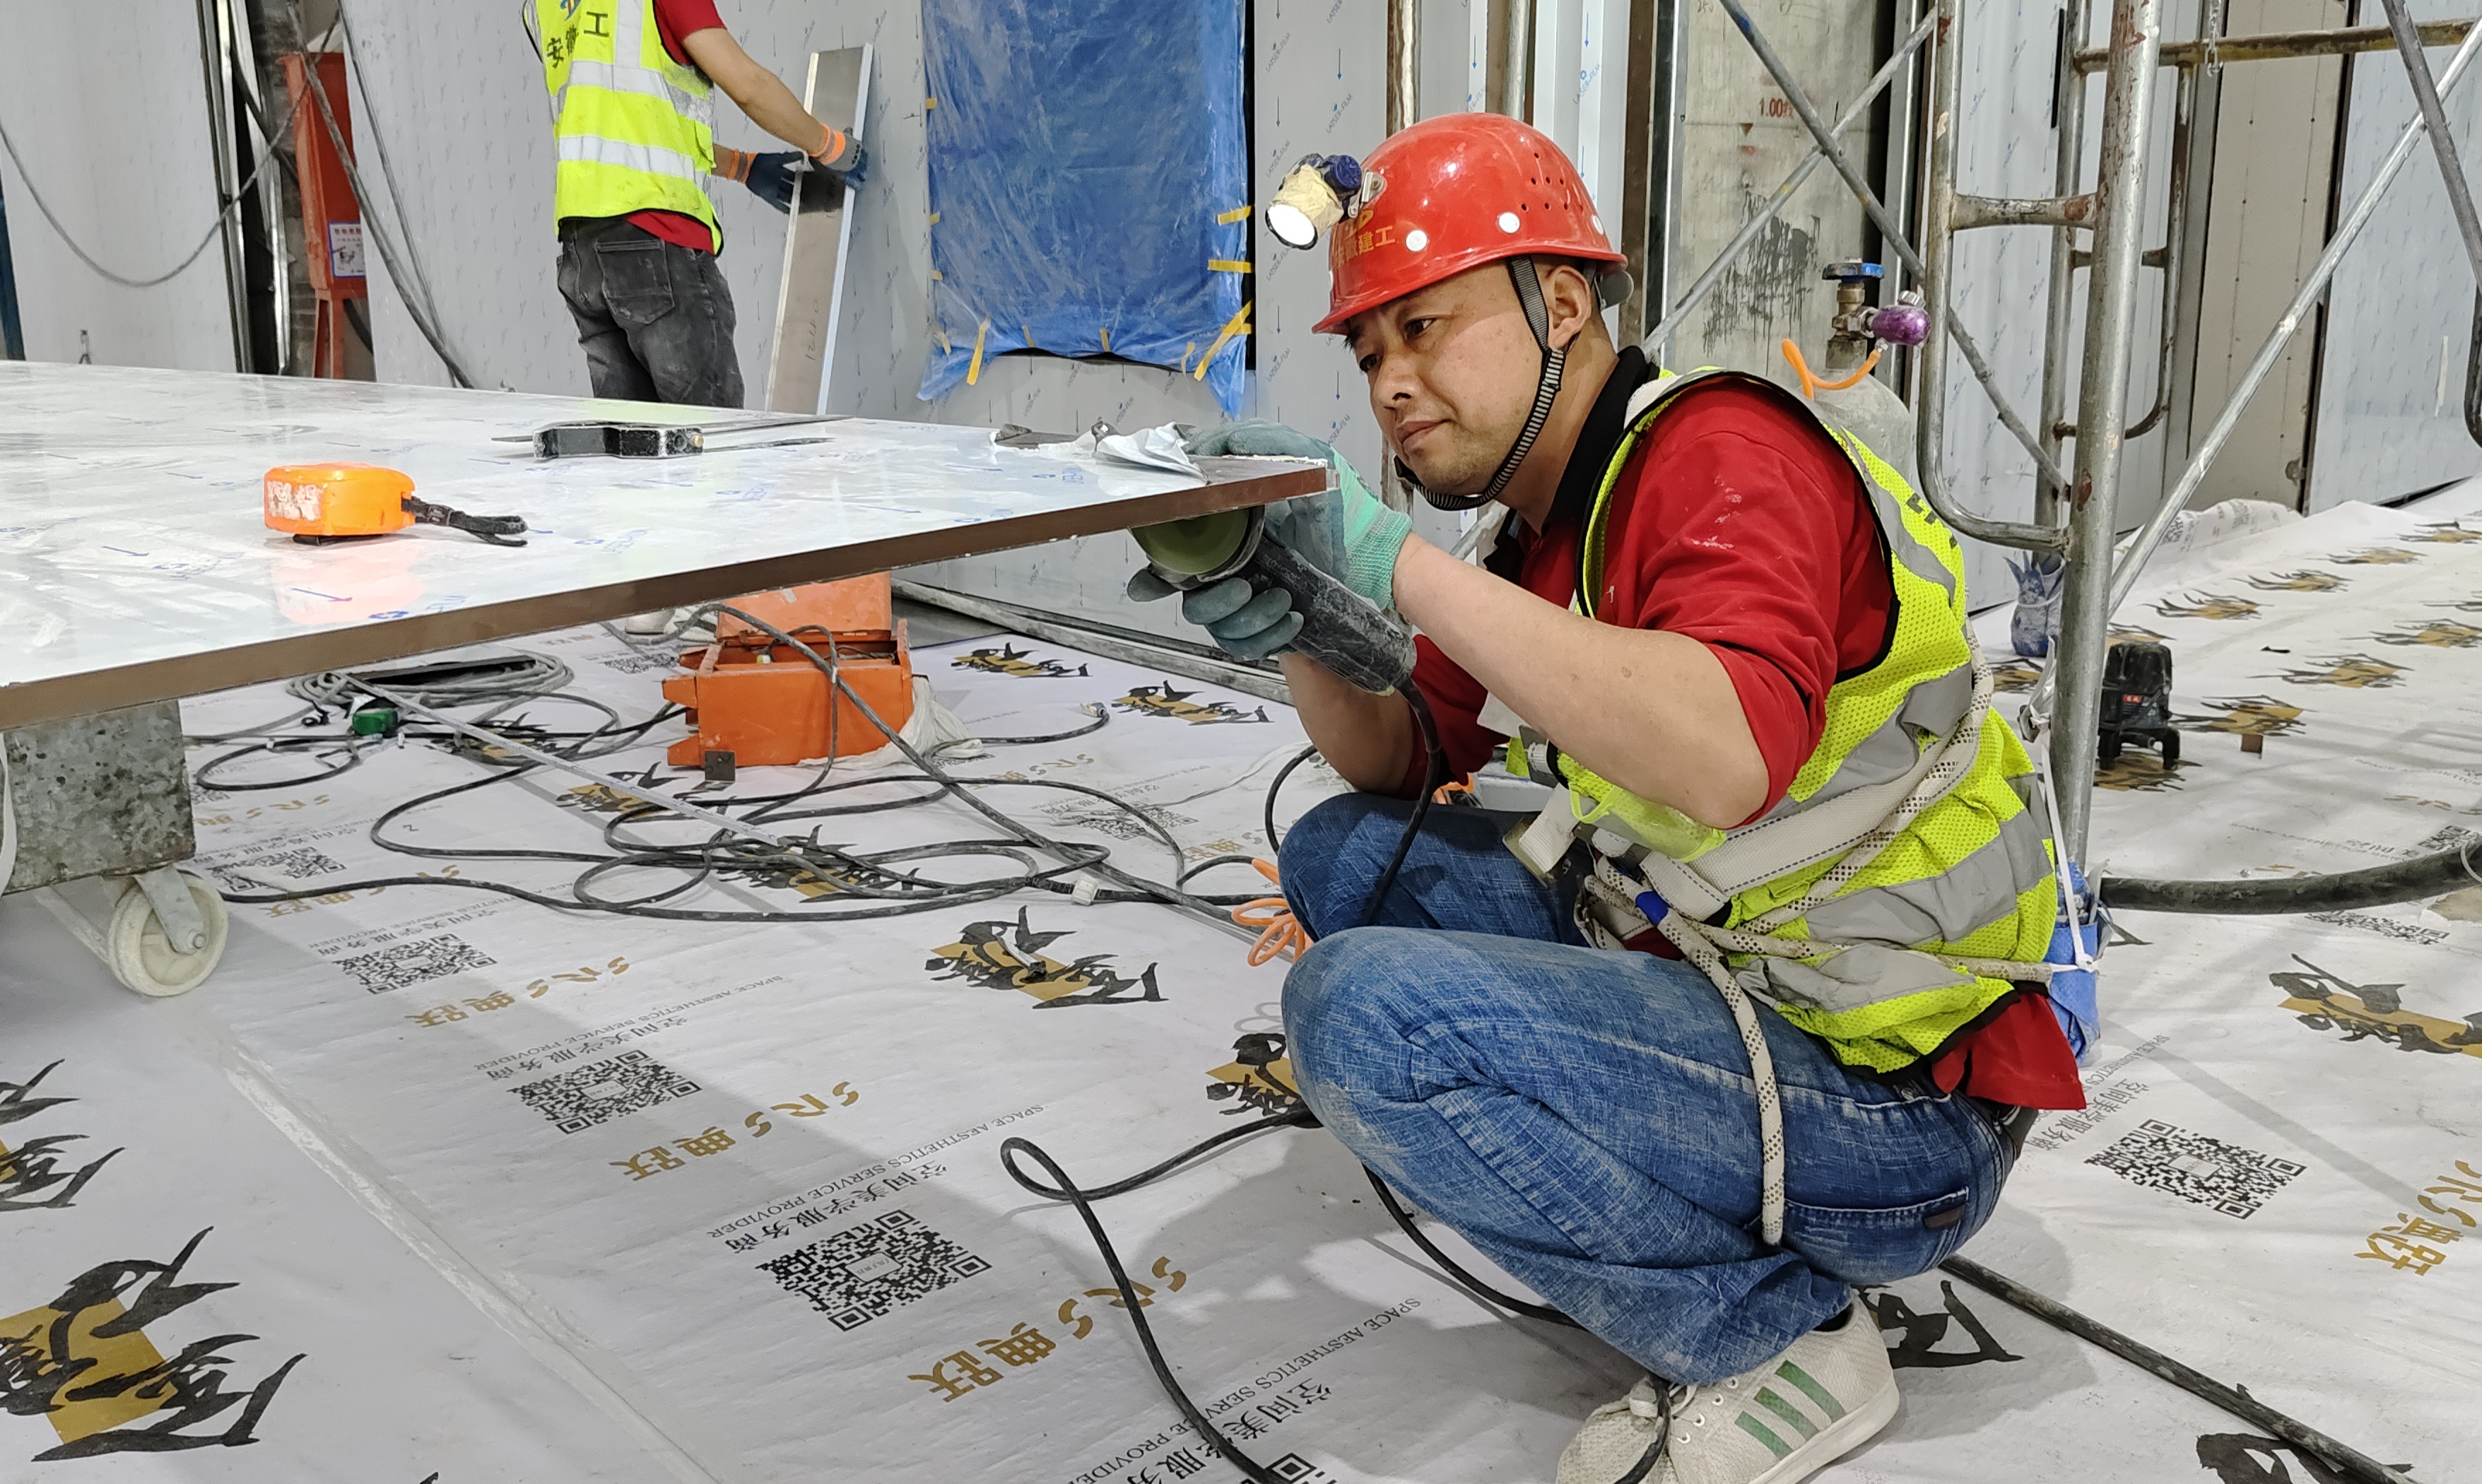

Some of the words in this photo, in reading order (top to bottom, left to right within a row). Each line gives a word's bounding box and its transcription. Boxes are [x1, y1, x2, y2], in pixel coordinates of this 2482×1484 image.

[526, 956, 630, 999] SRS
[733, 974, 784, 991] SPACE
[637, 987, 732, 1023] AESTHETICS
[486, 1015, 688, 1081] 空间美学服务商
[564, 1018, 636, 1044] SERVICE
[473, 1040, 563, 1071] PROVIDER
[744, 1081, 859, 1138] SRS
[992, 1105, 1044, 1127] SPACE
[887, 1123, 990, 1167] AESTHETICS
[807, 1164, 887, 1199] SERVICE
[707, 1196, 808, 1238] PROVIDER
[724, 1160, 948, 1254] 空间美学服务商
[1363, 1297, 1421, 1331] SPACE
[1255, 1326, 1365, 1389] AESTHETICS
[1169, 1385, 1257, 1437] SERVCE
